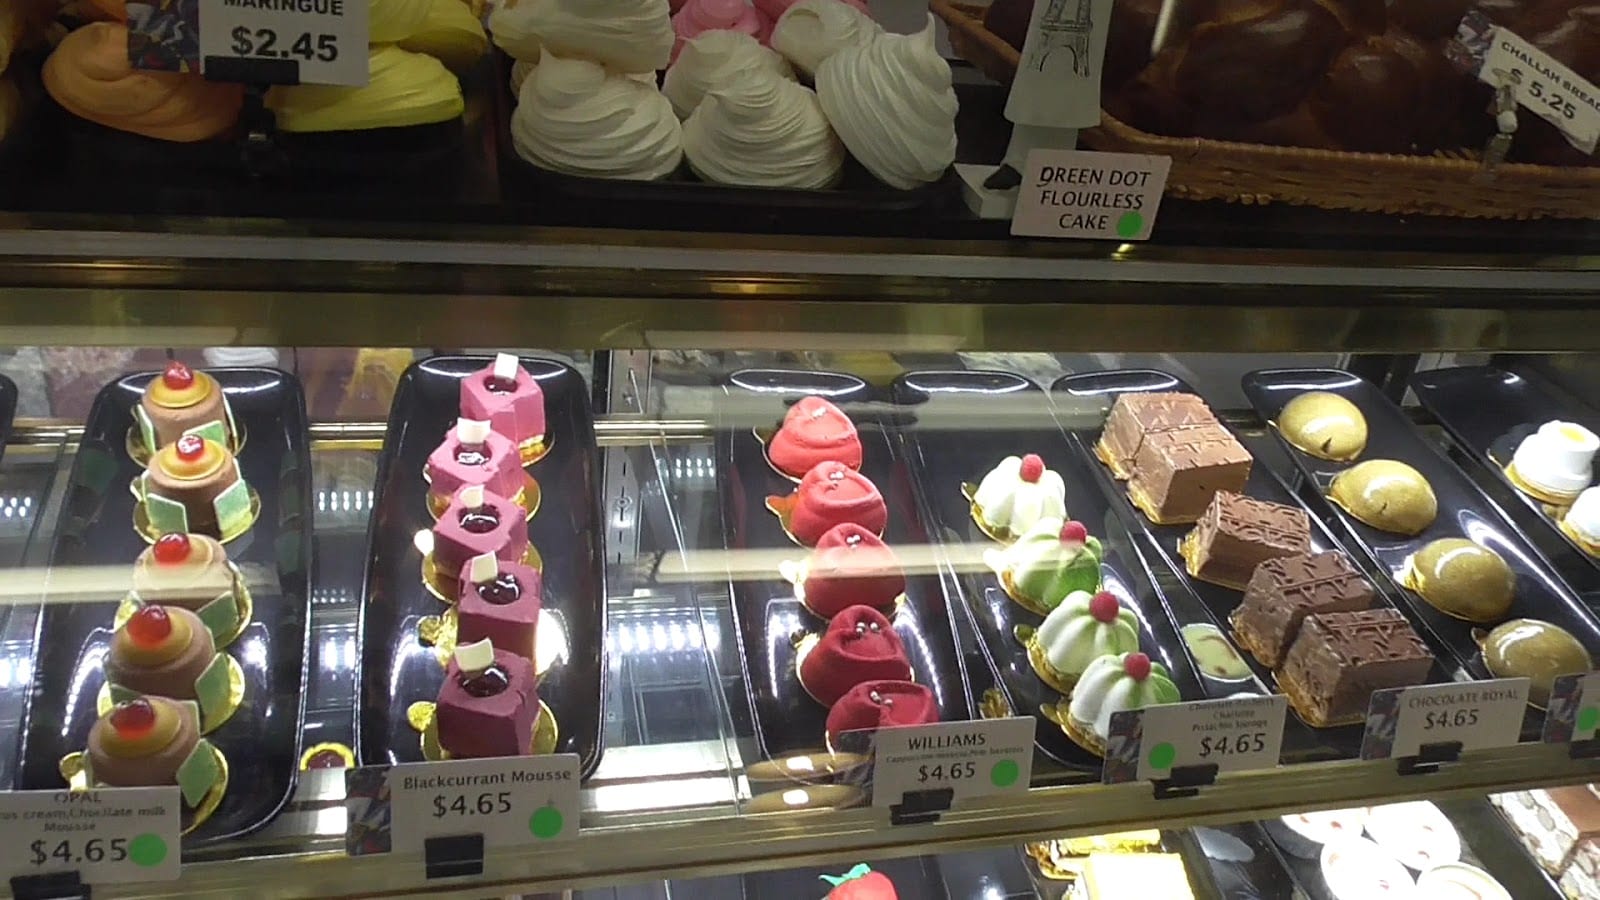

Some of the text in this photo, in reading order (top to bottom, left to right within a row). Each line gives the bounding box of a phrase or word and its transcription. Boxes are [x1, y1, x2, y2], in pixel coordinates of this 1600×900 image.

[231, 26, 338, 62] $2.45
[1501, 41, 1561, 84] CHALLAH
[1528, 81, 1577, 120] 5.25
[1109, 170, 1152, 187] DOT
[1040, 190, 1144, 210] FLOURLESS
[1059, 213, 1109, 230] CAKE
[1409, 692, 1478, 709] CHOCOLATE
[1424, 709, 1479, 730] $4.65
[908, 733, 986, 751] WILLIAMS
[1199, 733, 1266, 758] $4.65
[403, 769, 572, 790] Blackcurrant Mousse
[918, 762, 976, 783] $4.65
[432, 792, 512, 818] $4.65
[30, 838, 128, 867] $4.65
